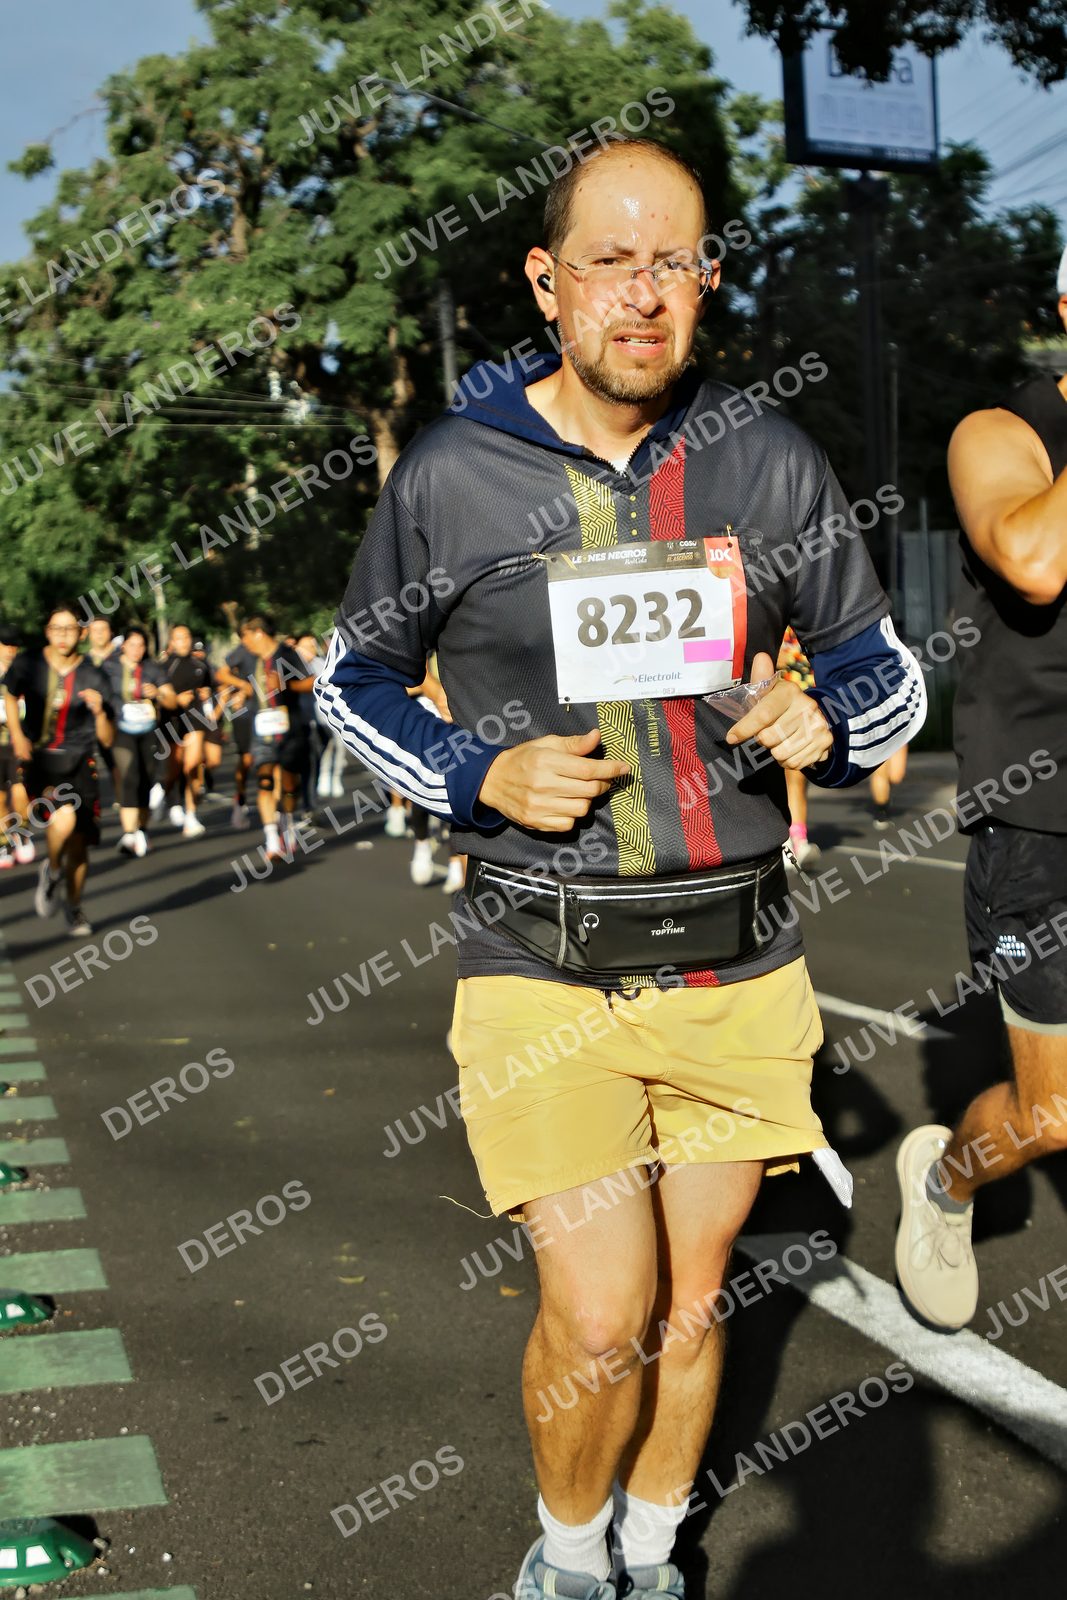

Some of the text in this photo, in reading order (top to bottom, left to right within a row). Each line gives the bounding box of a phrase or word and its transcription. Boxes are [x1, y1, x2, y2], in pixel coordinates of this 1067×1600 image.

[607, 548, 647, 560] NEGROS
[709, 548, 733, 562] 10K
[576, 588, 706, 648] 8232
[637, 671, 682, 683] Electrolit
[650, 926, 686, 936] TOPTIME
